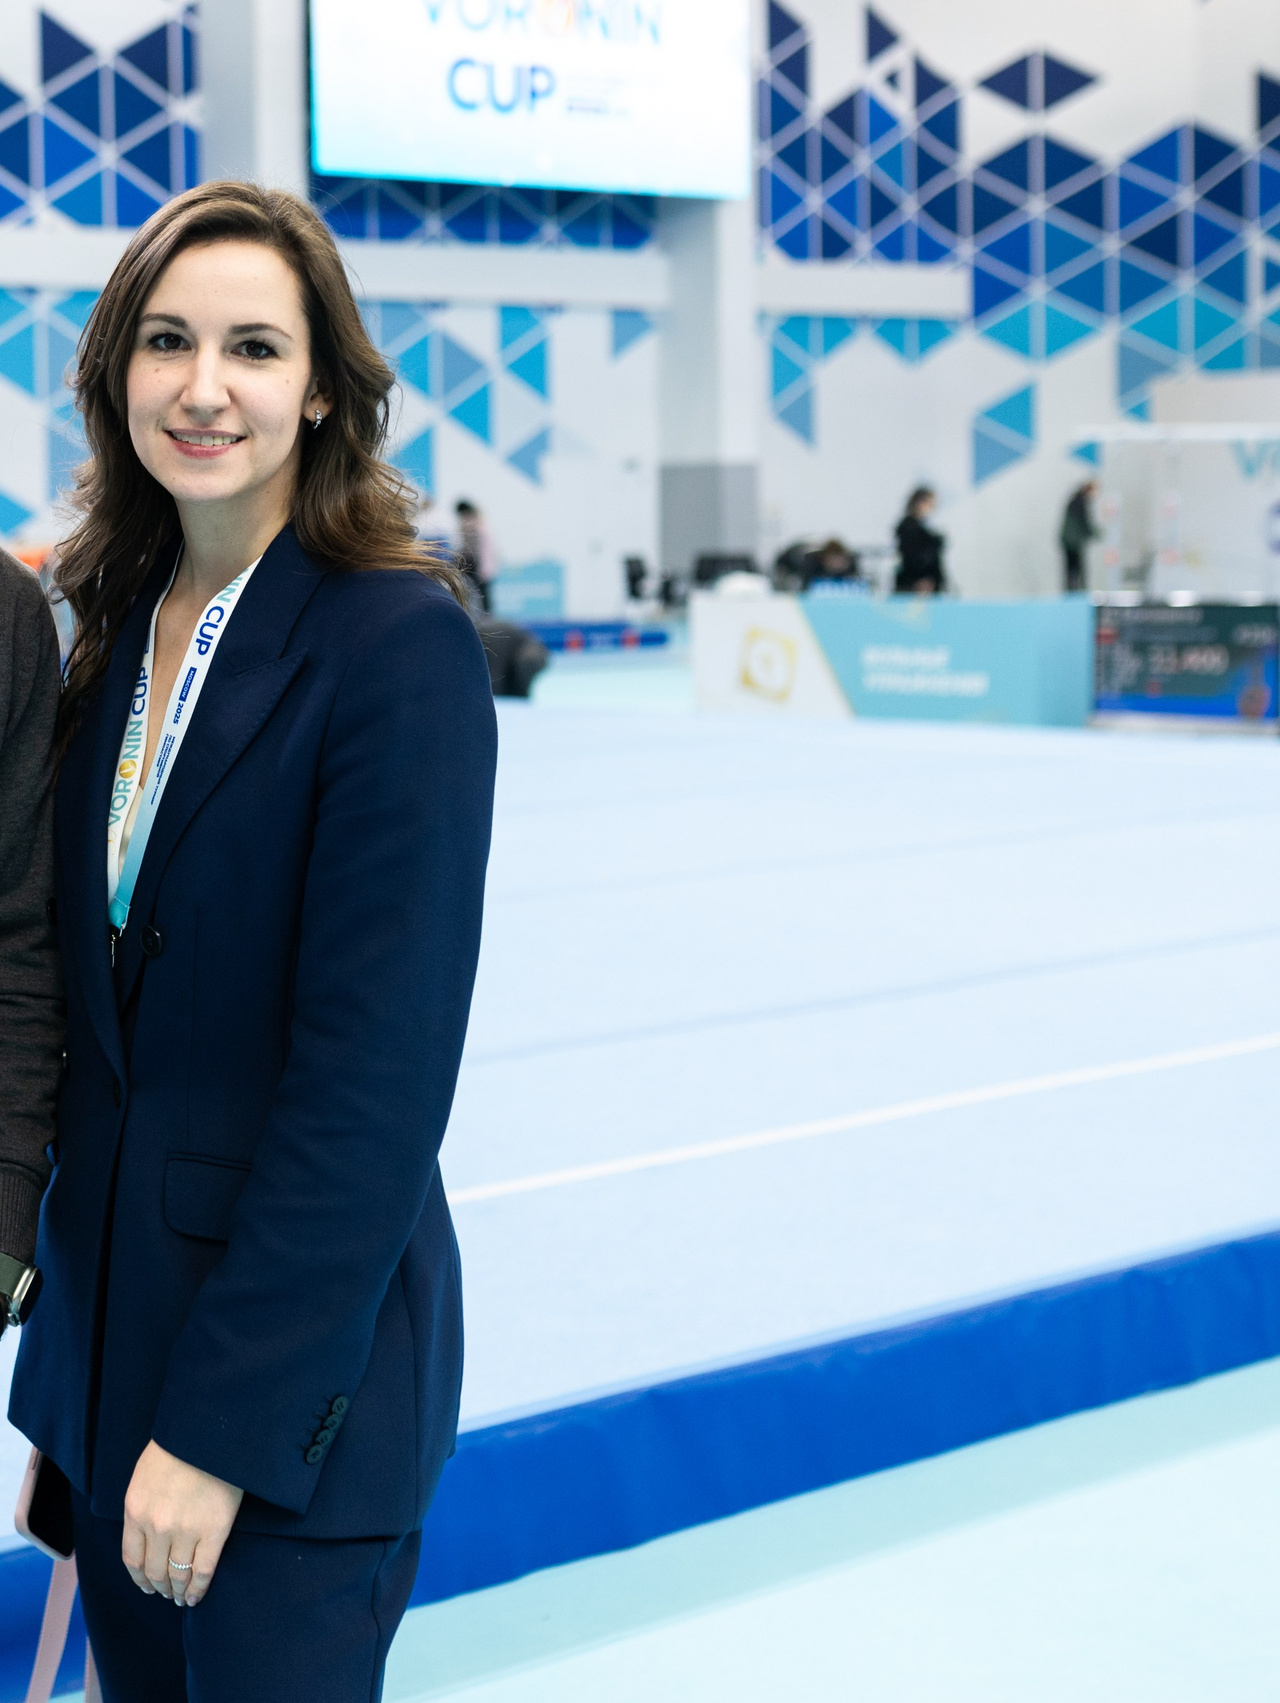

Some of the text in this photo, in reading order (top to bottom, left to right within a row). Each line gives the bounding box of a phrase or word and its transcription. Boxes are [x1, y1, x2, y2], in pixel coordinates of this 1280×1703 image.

[447, 58, 557, 113] CUP
[195, 606, 225, 656] CUP
[181, 670, 195, 699] MOSCOW
[173, 703, 184, 725] 2025
[108, 666, 148, 827] VORONIN CUP
